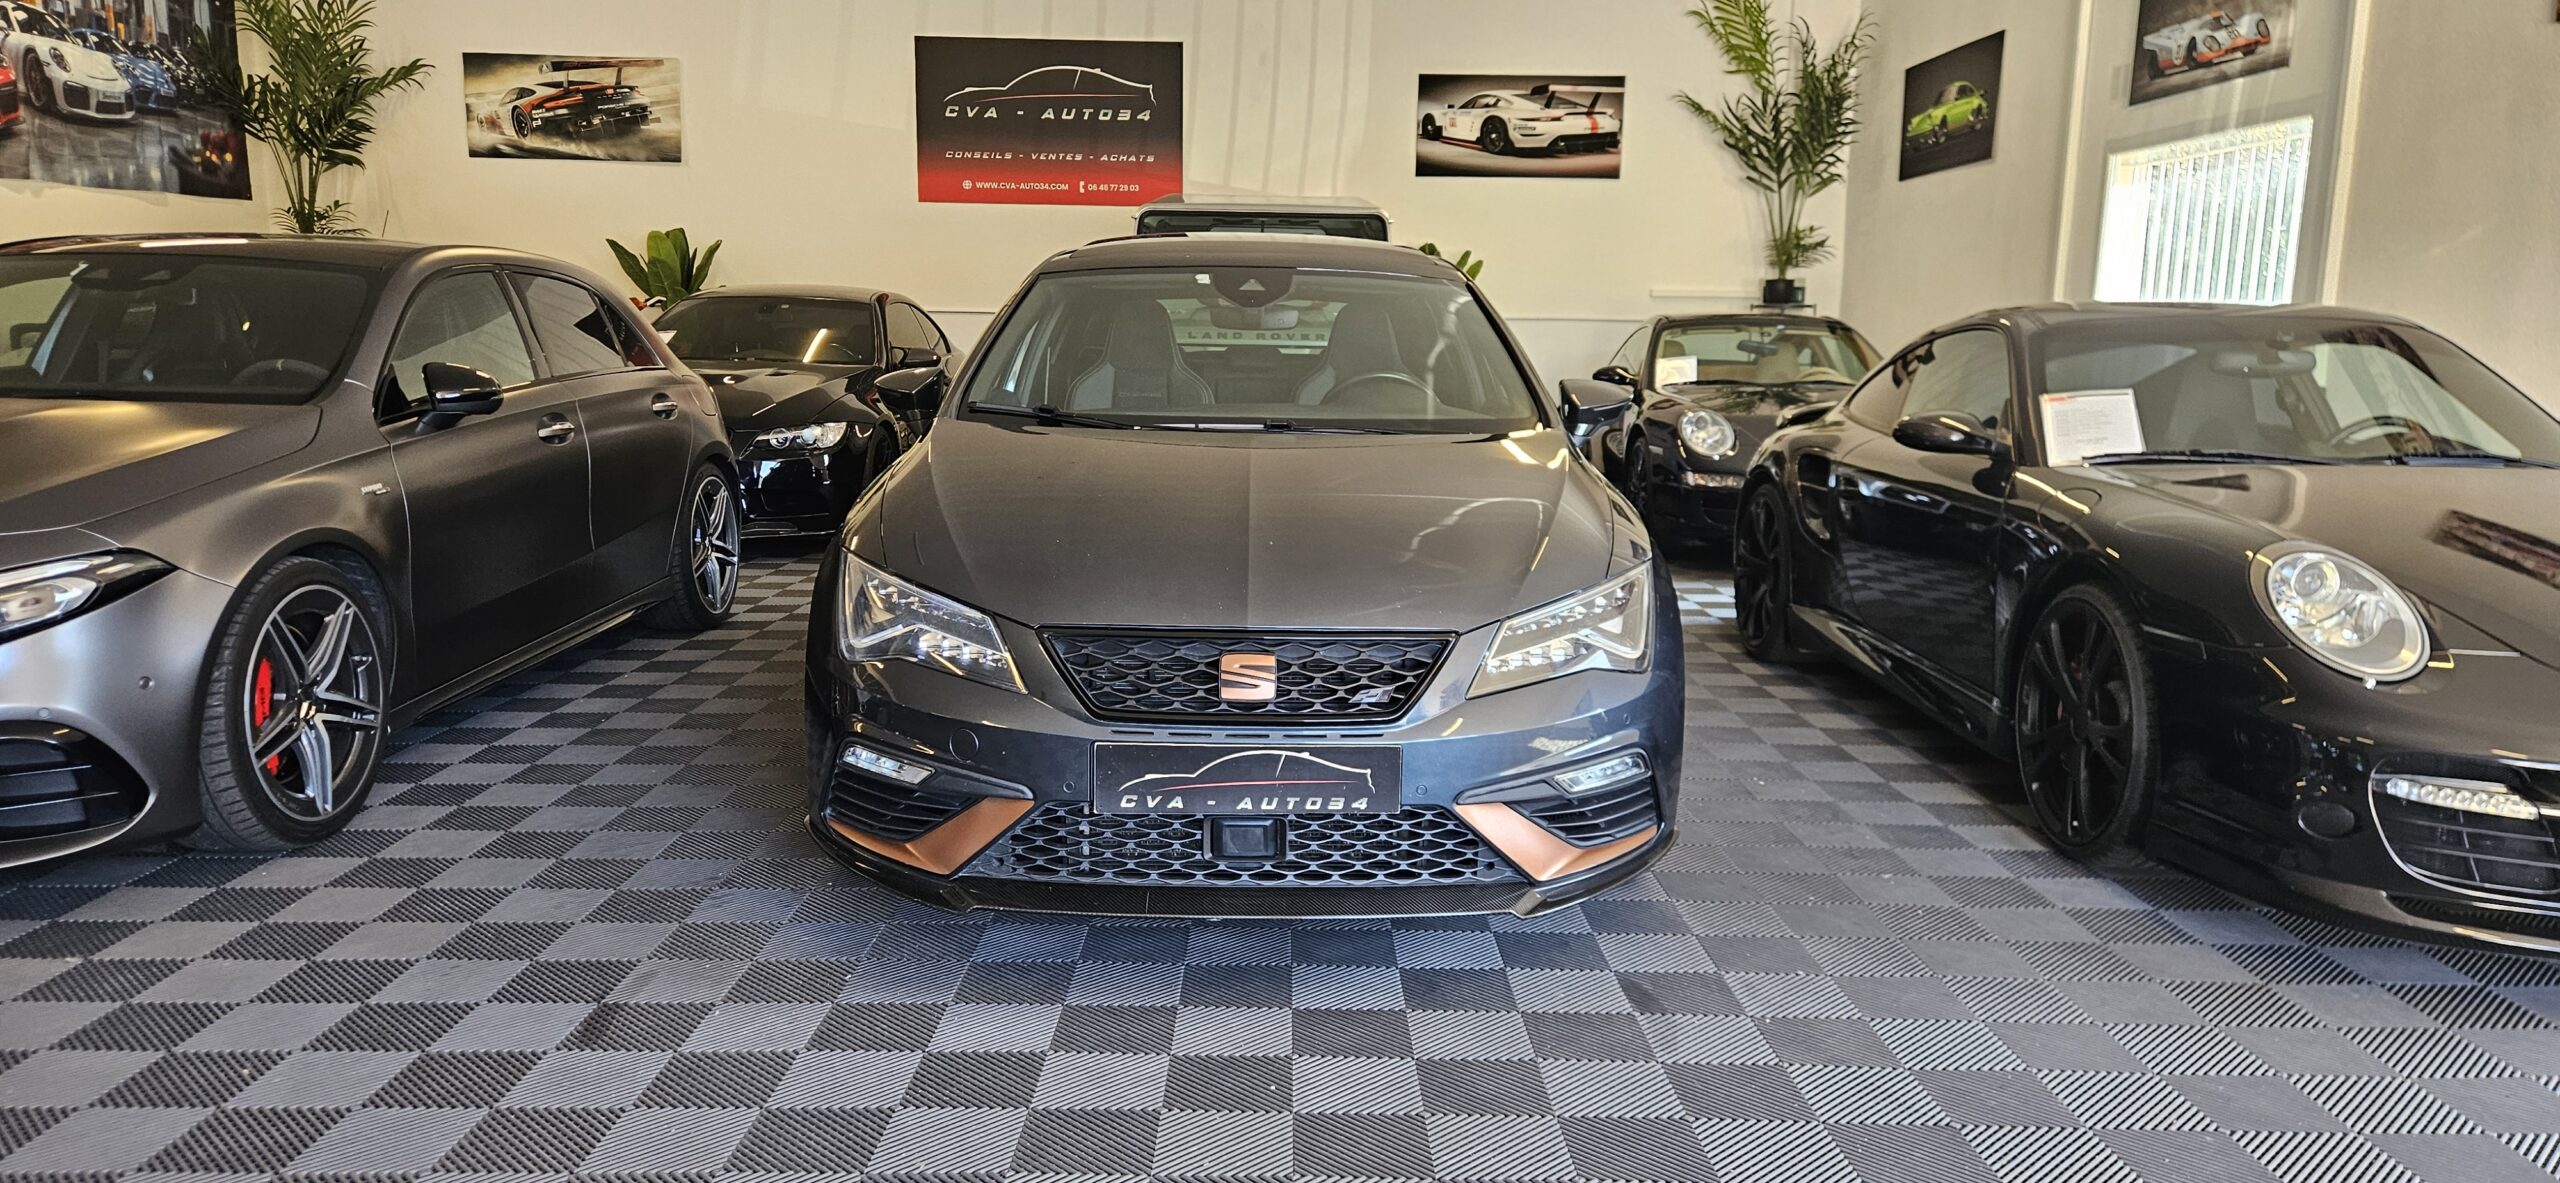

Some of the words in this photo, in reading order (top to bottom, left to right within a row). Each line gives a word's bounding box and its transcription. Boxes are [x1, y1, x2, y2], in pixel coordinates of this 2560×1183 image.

[944, 105, 998, 118] CVA
[1041, 108, 1152, 122] AUTO34
[945, 150, 1013, 160] CONSEILS
[1031, 152, 1083, 161] VENTES
[1100, 154, 1155, 162] ACHATS
[975, 181, 1069, 191] WWW.CVA-AUTO34.COM
[1087, 183, 1098, 192] 06
[1098, 183, 1109, 192] 46
[1109, 183, 1118, 192] 77
[1129, 184, 1140, 192] 03
[1187, 331, 1243, 340] LAND
[1255, 332, 1327, 341] ROVER
[1119, 794, 1184, 809] CVA
[1236, 796, 1370, 812] AUTO34
